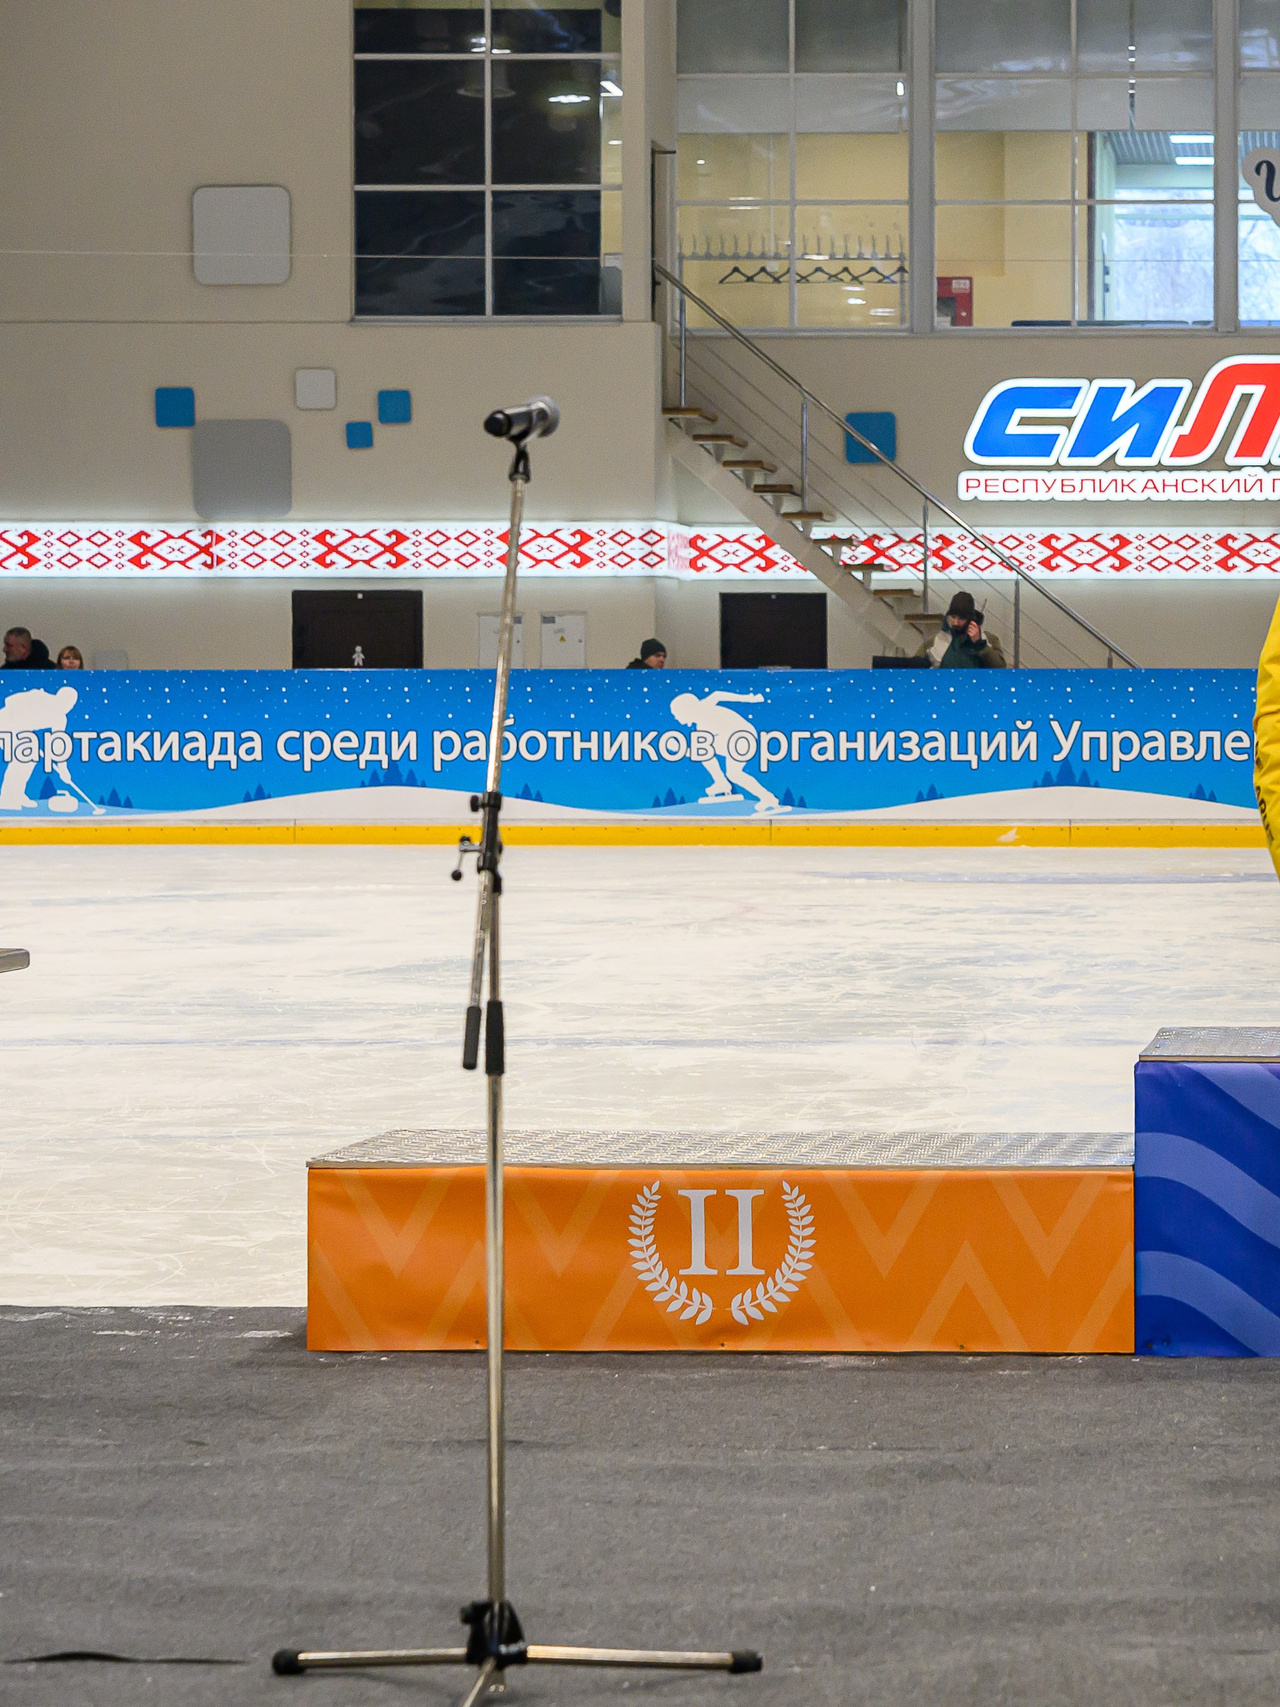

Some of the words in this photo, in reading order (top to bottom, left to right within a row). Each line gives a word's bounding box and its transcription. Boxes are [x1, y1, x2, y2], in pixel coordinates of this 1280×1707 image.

[965, 473, 1263, 494] РЕСПУБЛИКАНСКИЙ
[276, 729, 418, 773] среди
[729, 720, 1038, 773] организаций
[1051, 719, 1257, 773] Управле
[678, 1189, 766, 1276] II
